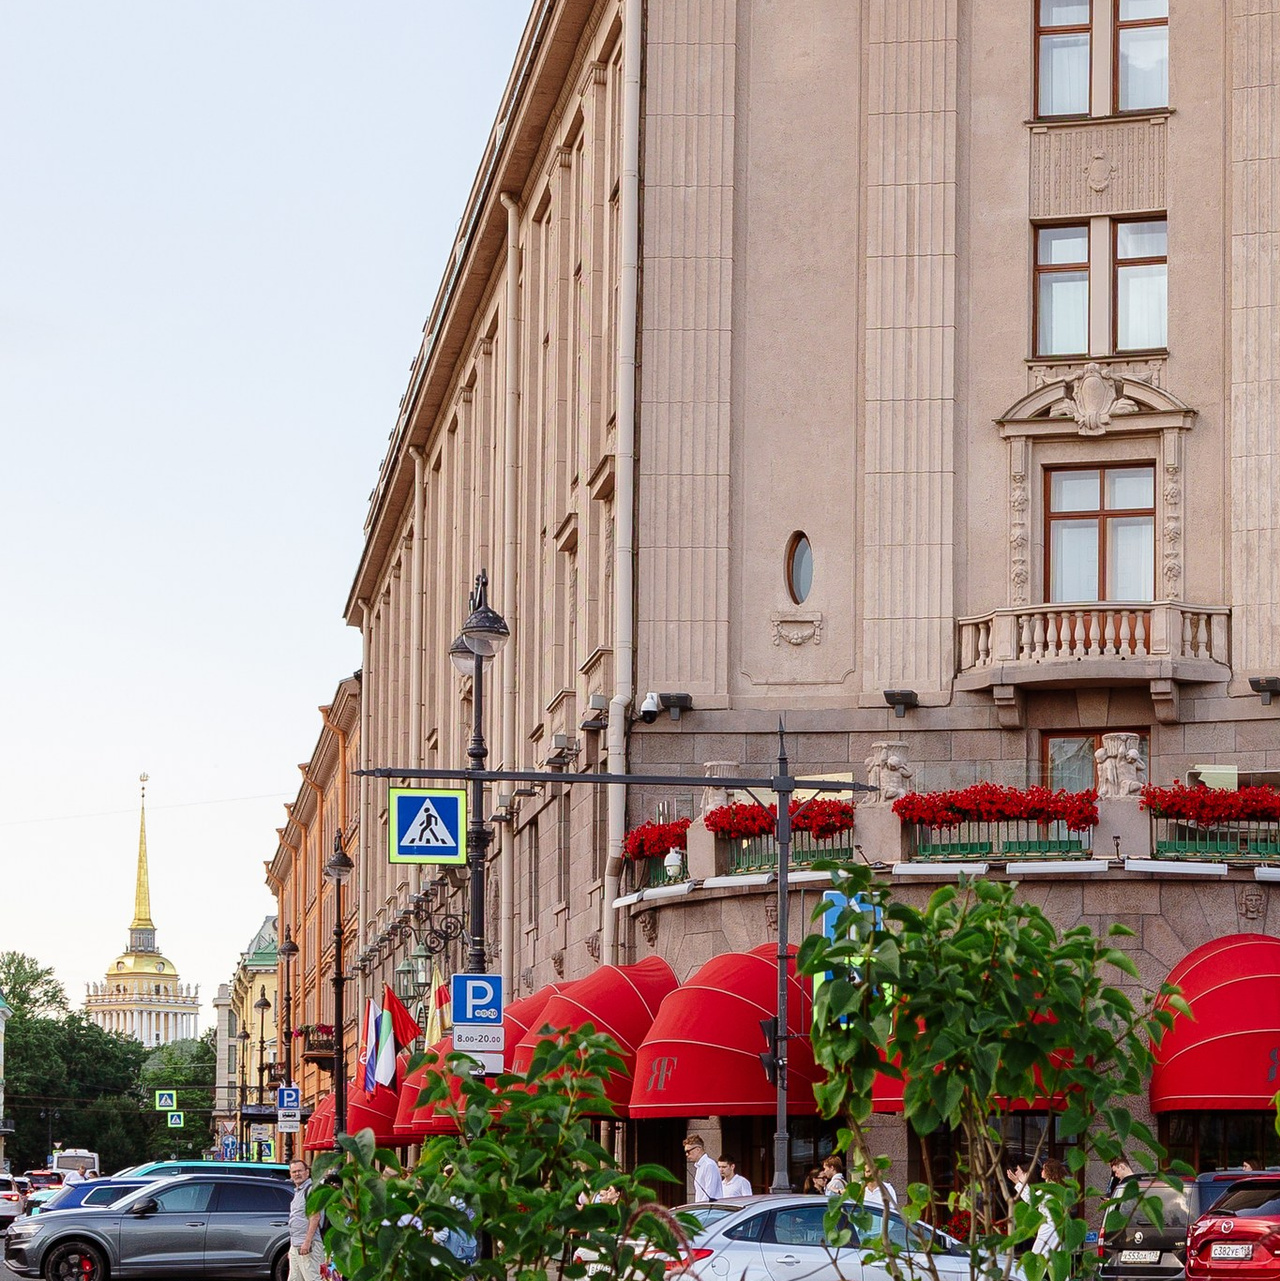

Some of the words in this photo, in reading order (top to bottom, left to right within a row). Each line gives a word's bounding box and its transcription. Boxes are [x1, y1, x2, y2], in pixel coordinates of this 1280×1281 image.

[466, 980, 494, 1019] P
[457, 1035, 501, 1043] 8.00-20.00
[284, 1090, 296, 1107] P
